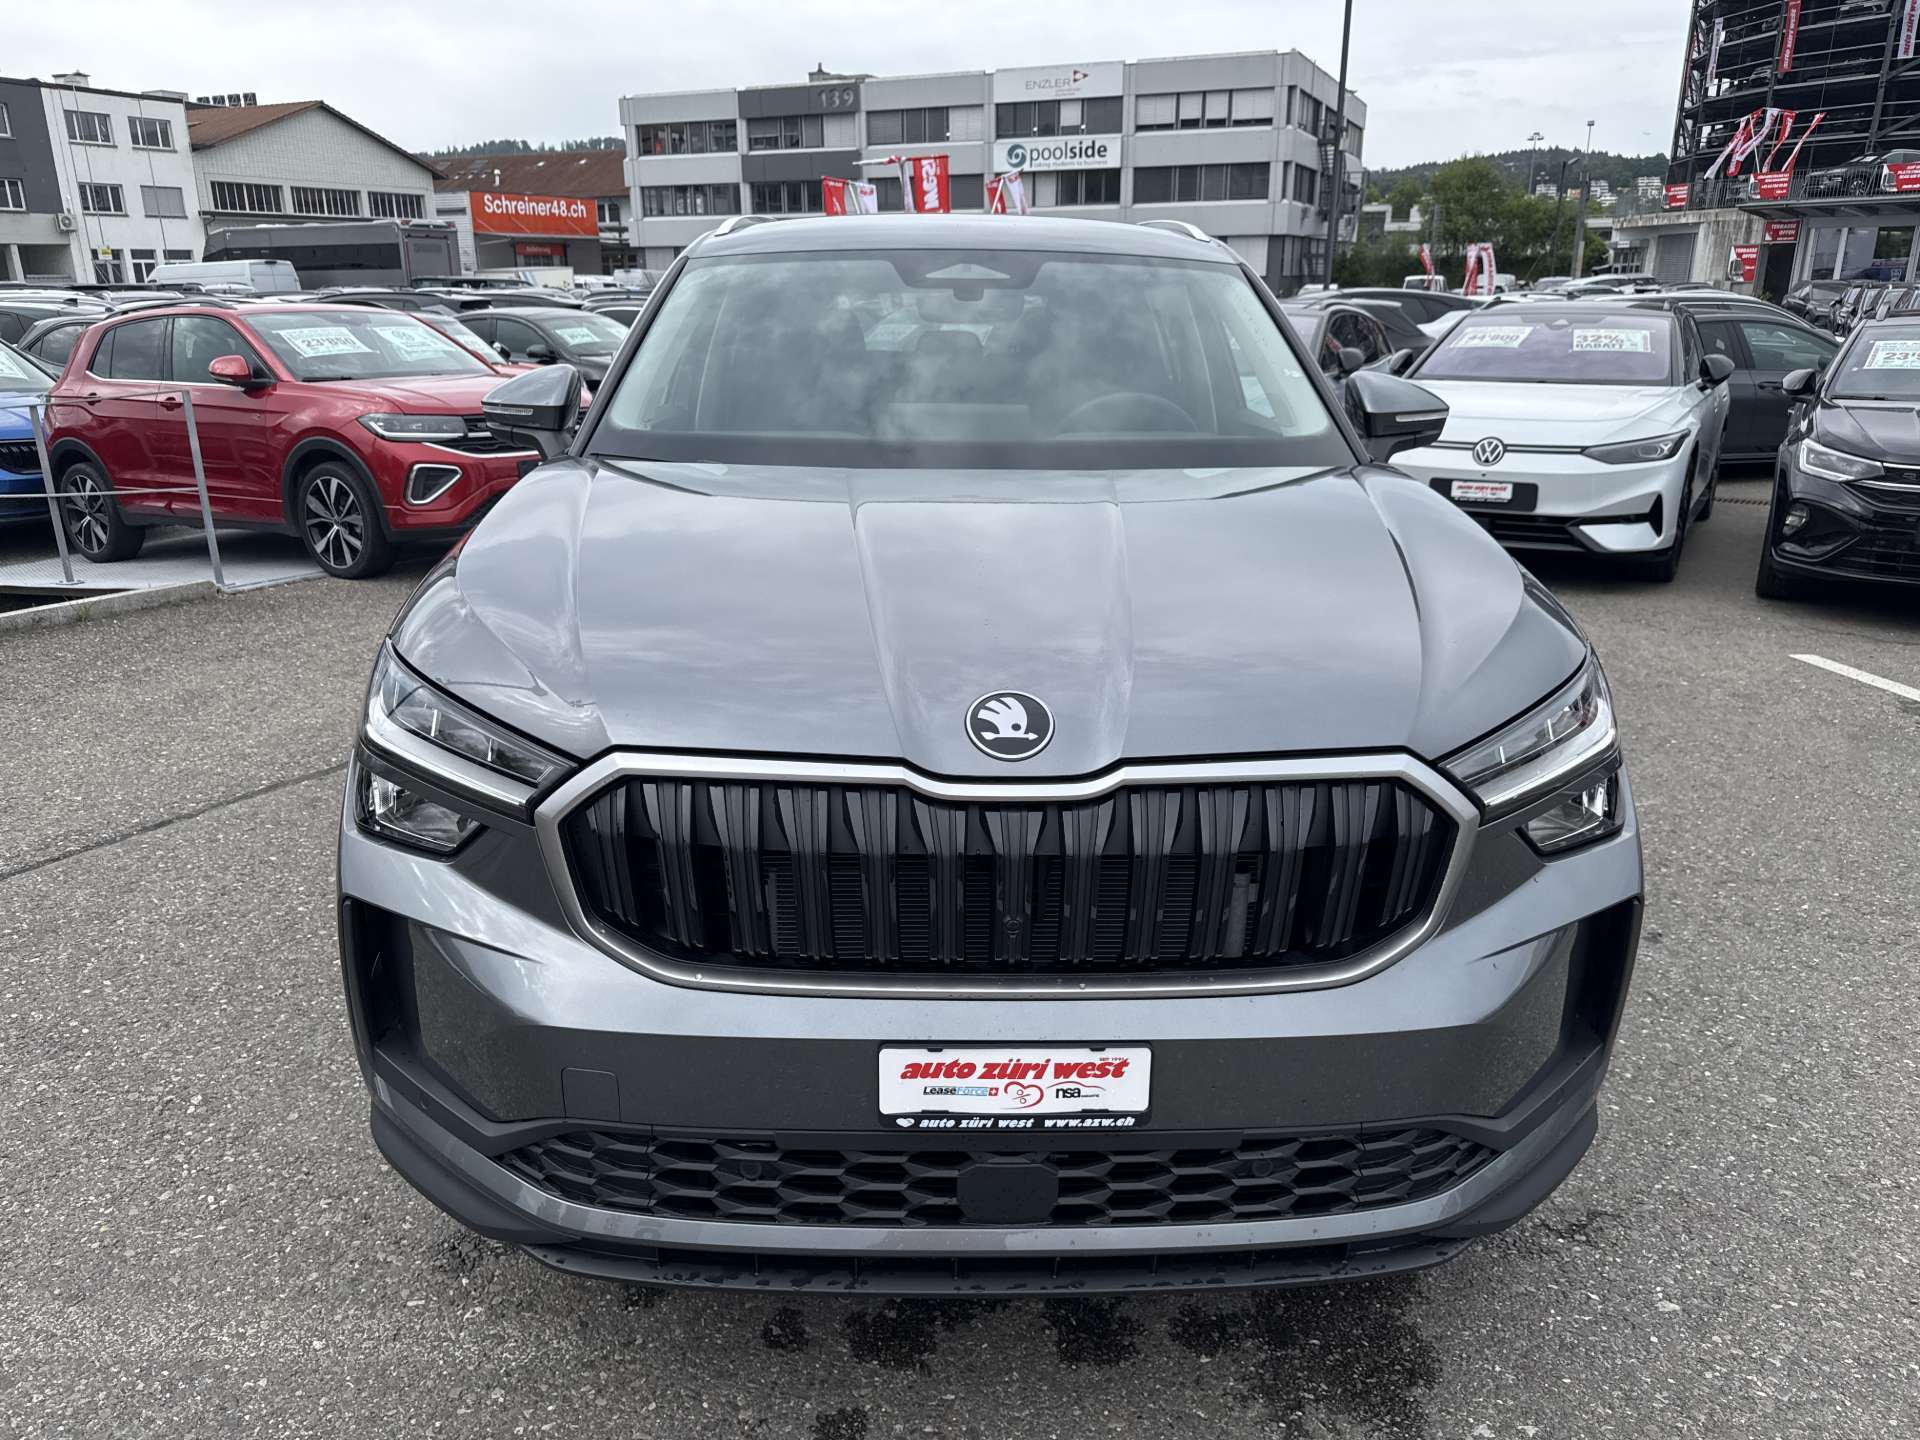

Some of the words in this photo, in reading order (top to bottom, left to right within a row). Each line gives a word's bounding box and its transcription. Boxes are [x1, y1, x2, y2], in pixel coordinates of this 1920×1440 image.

[1025, 79, 1071, 90] ENZLER
[819, 89, 855, 108] 139
[1030, 140, 1108, 168] poolside
[483, 193, 587, 218] Schreiner48.ch
[900, 1059, 977, 1080] auto
[977, 1058, 1051, 1080] züri
[1053, 1058, 1130, 1079] west
[1055, 1088, 1081, 1099] nsa
[919, 1118, 955, 1128] auto
[958, 1116, 995, 1128] züri
[998, 1118, 1035, 1128] west
[1044, 1116, 1136, 1128] www.azw.ch
